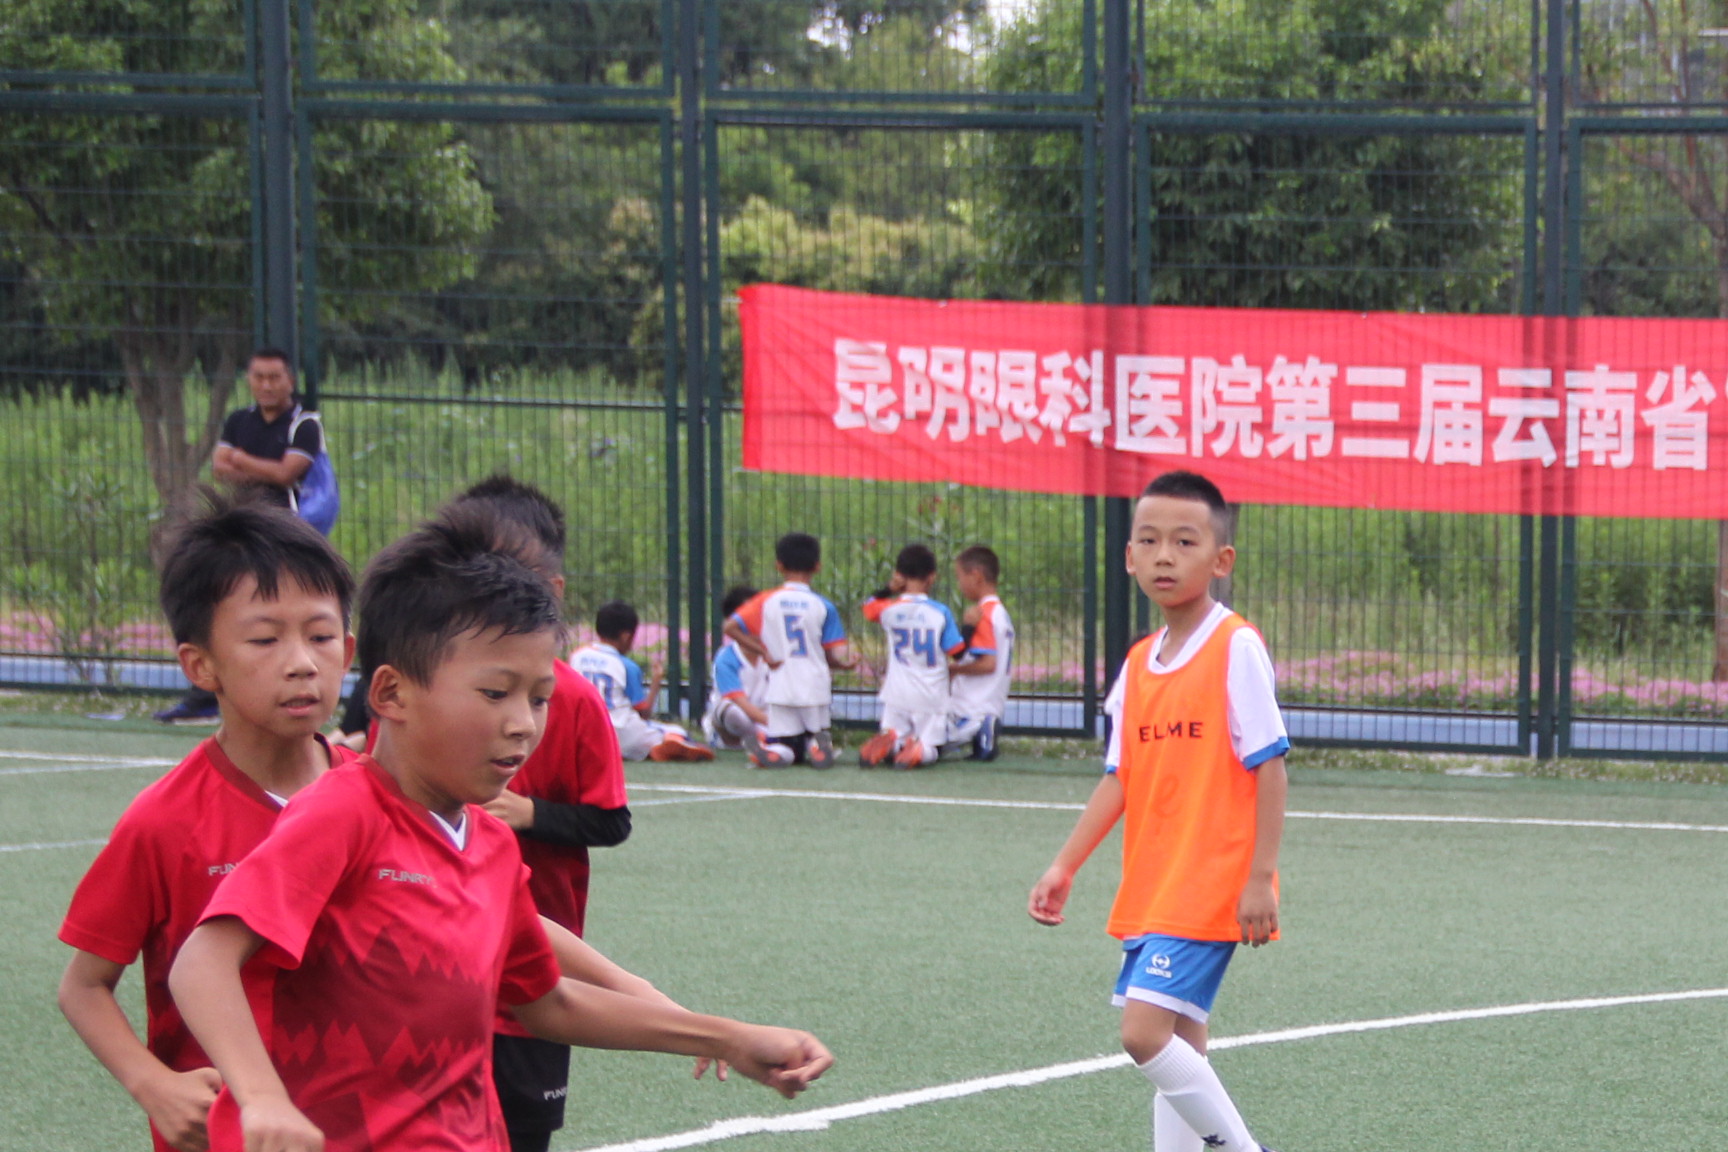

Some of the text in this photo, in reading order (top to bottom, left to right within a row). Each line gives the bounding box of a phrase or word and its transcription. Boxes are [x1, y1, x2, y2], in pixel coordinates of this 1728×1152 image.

[784, 614, 807, 657] 5
[892, 627, 937, 668] 24
[1139, 721, 1203, 742] ELME
